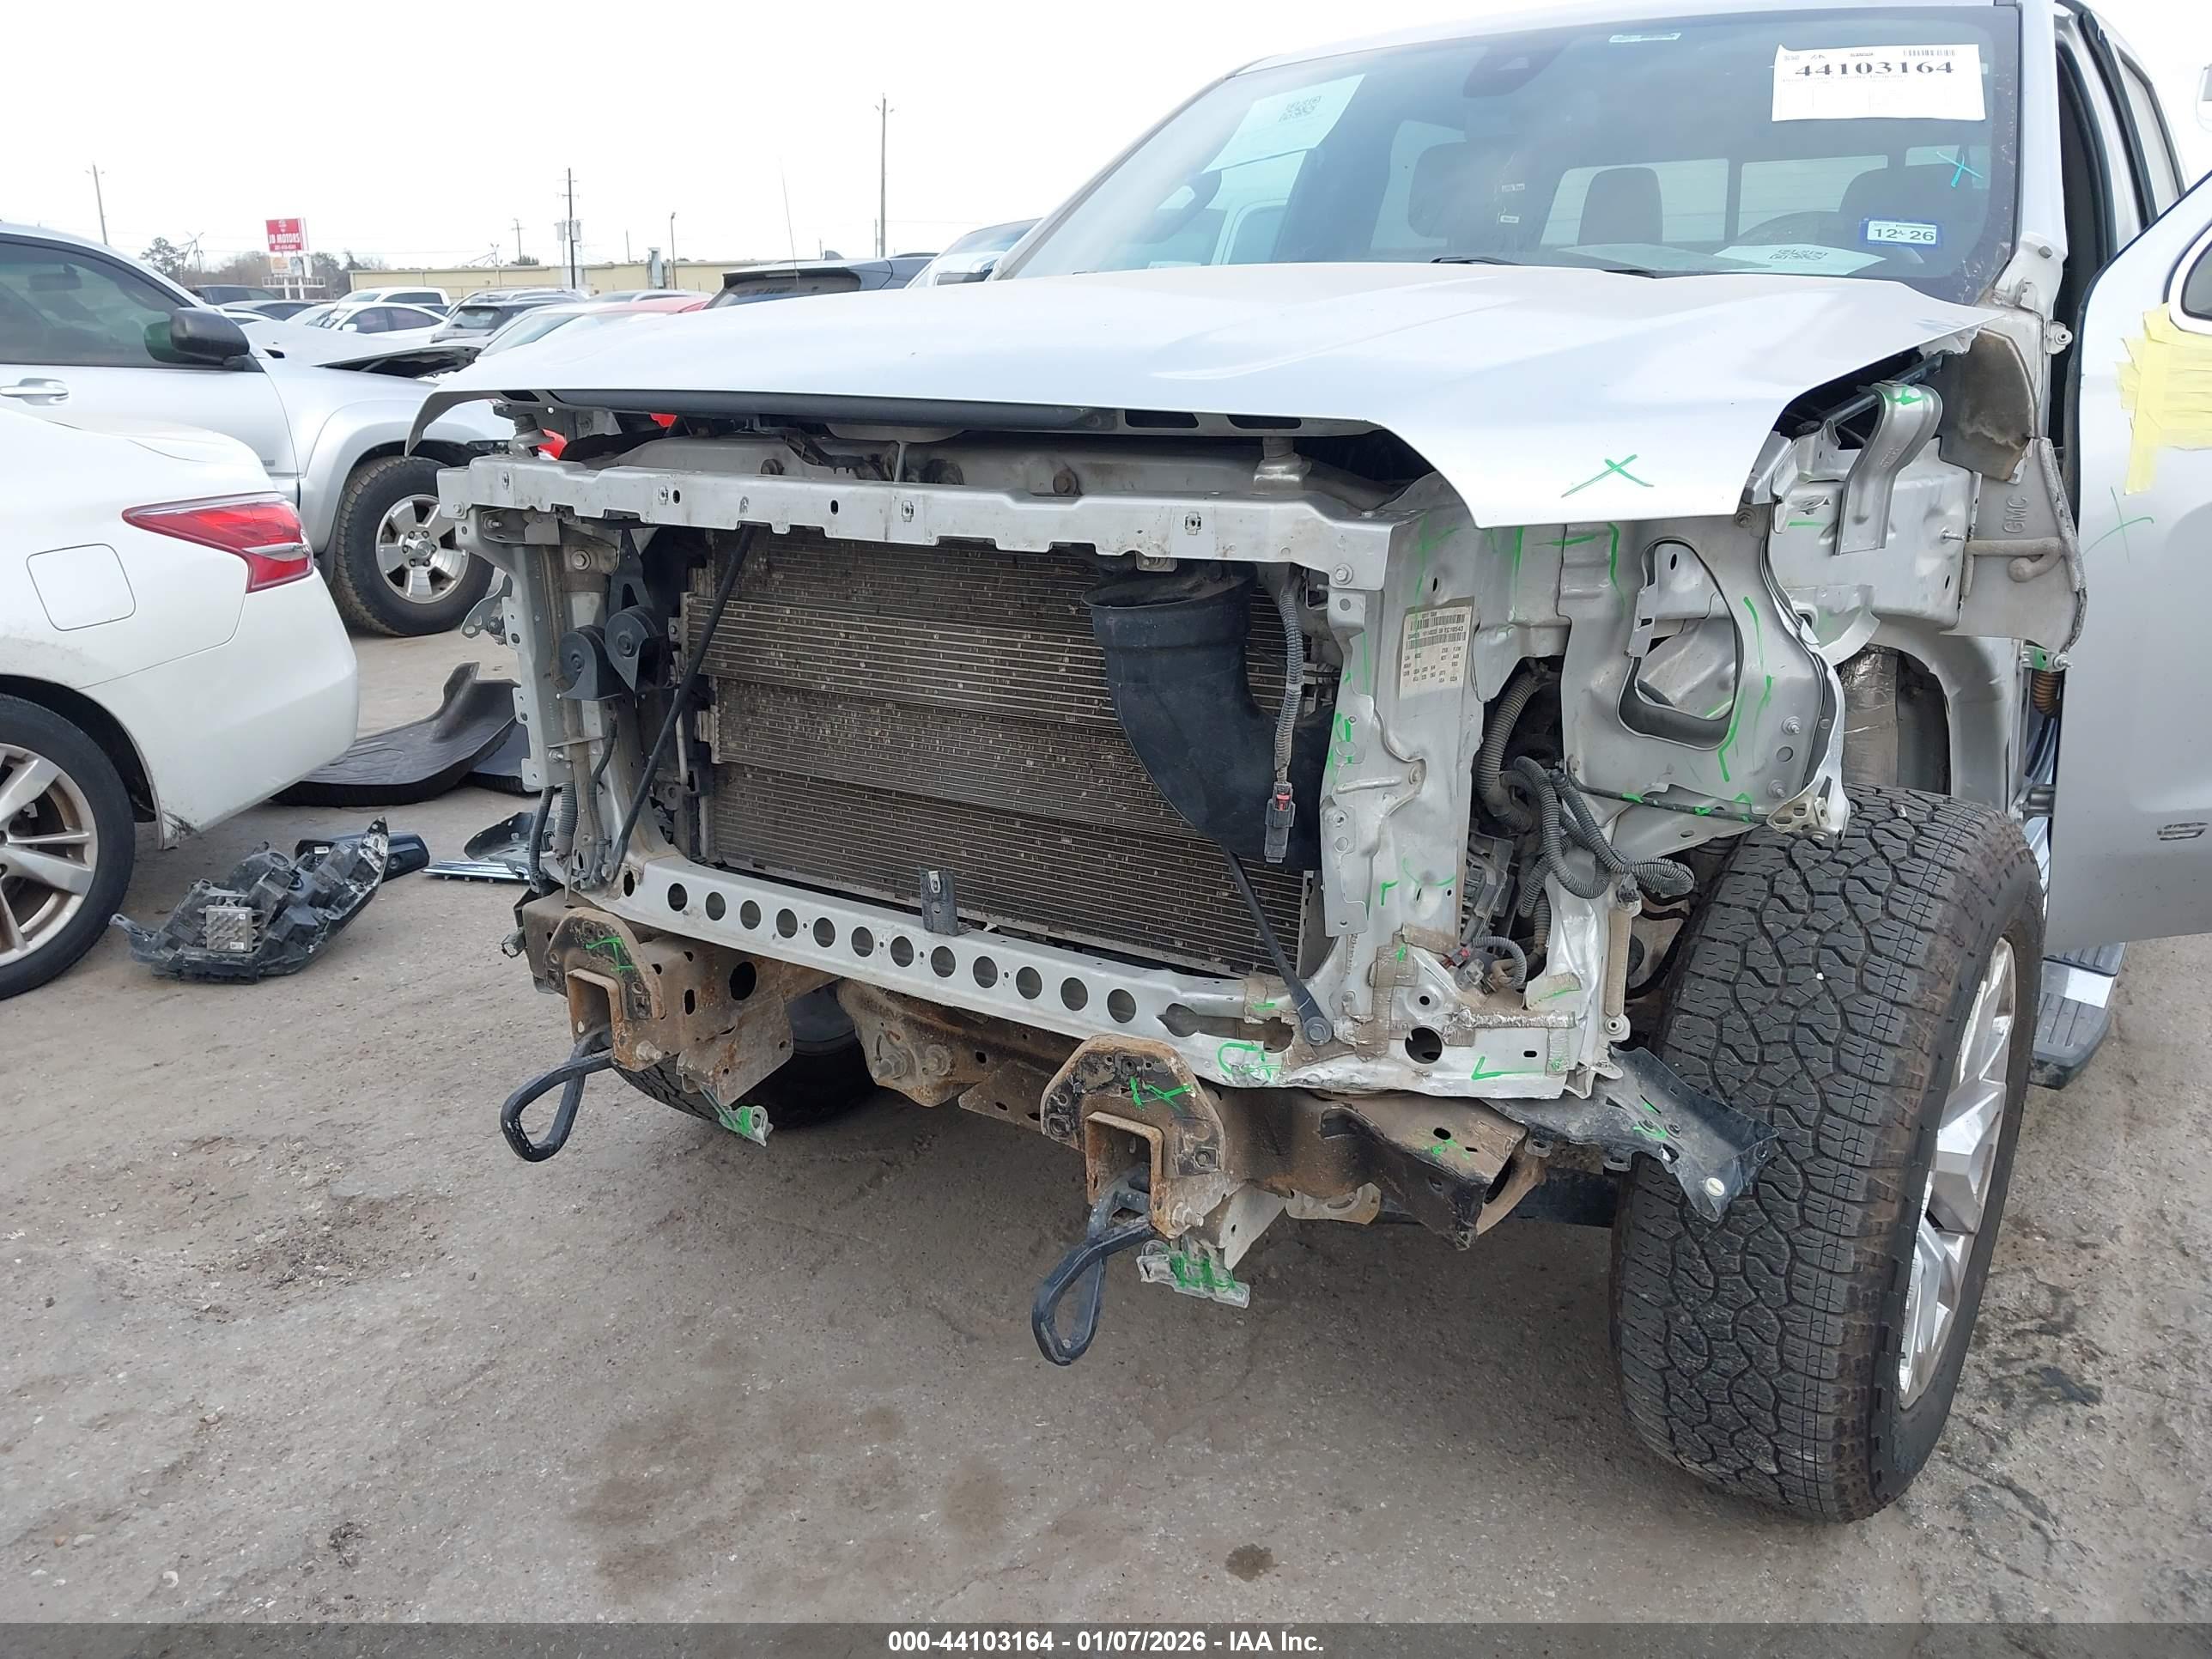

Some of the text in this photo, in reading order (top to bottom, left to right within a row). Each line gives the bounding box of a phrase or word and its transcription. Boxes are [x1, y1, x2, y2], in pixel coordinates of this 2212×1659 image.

[1795, 61, 1954, 76] 44103164
[276, 233, 300, 244] MOTORS
[1874, 228, 1935, 241] 12 26
[2003, 495, 2027, 533] GMC
